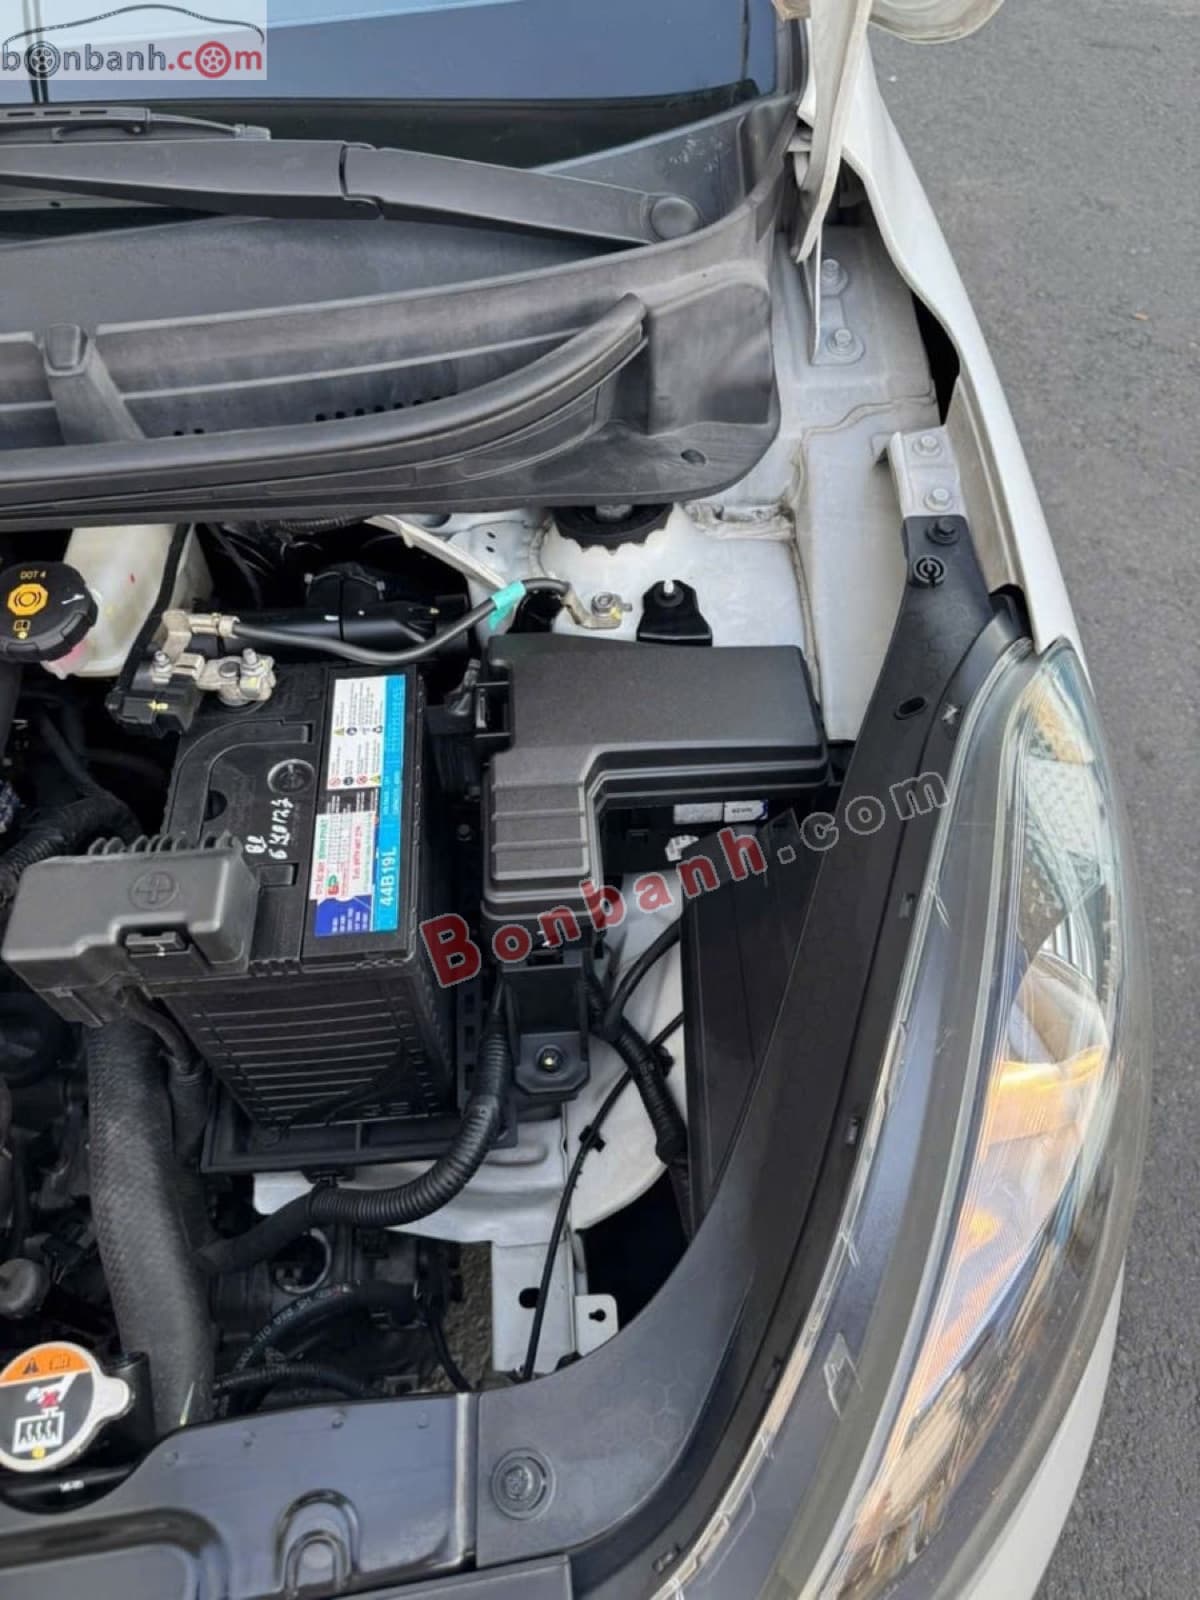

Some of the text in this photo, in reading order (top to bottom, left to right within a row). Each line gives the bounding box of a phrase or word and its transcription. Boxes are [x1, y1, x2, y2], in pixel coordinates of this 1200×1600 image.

[20, 570, 47, 579] DOT 4
[380, 846, 397, 907] 44B19L
